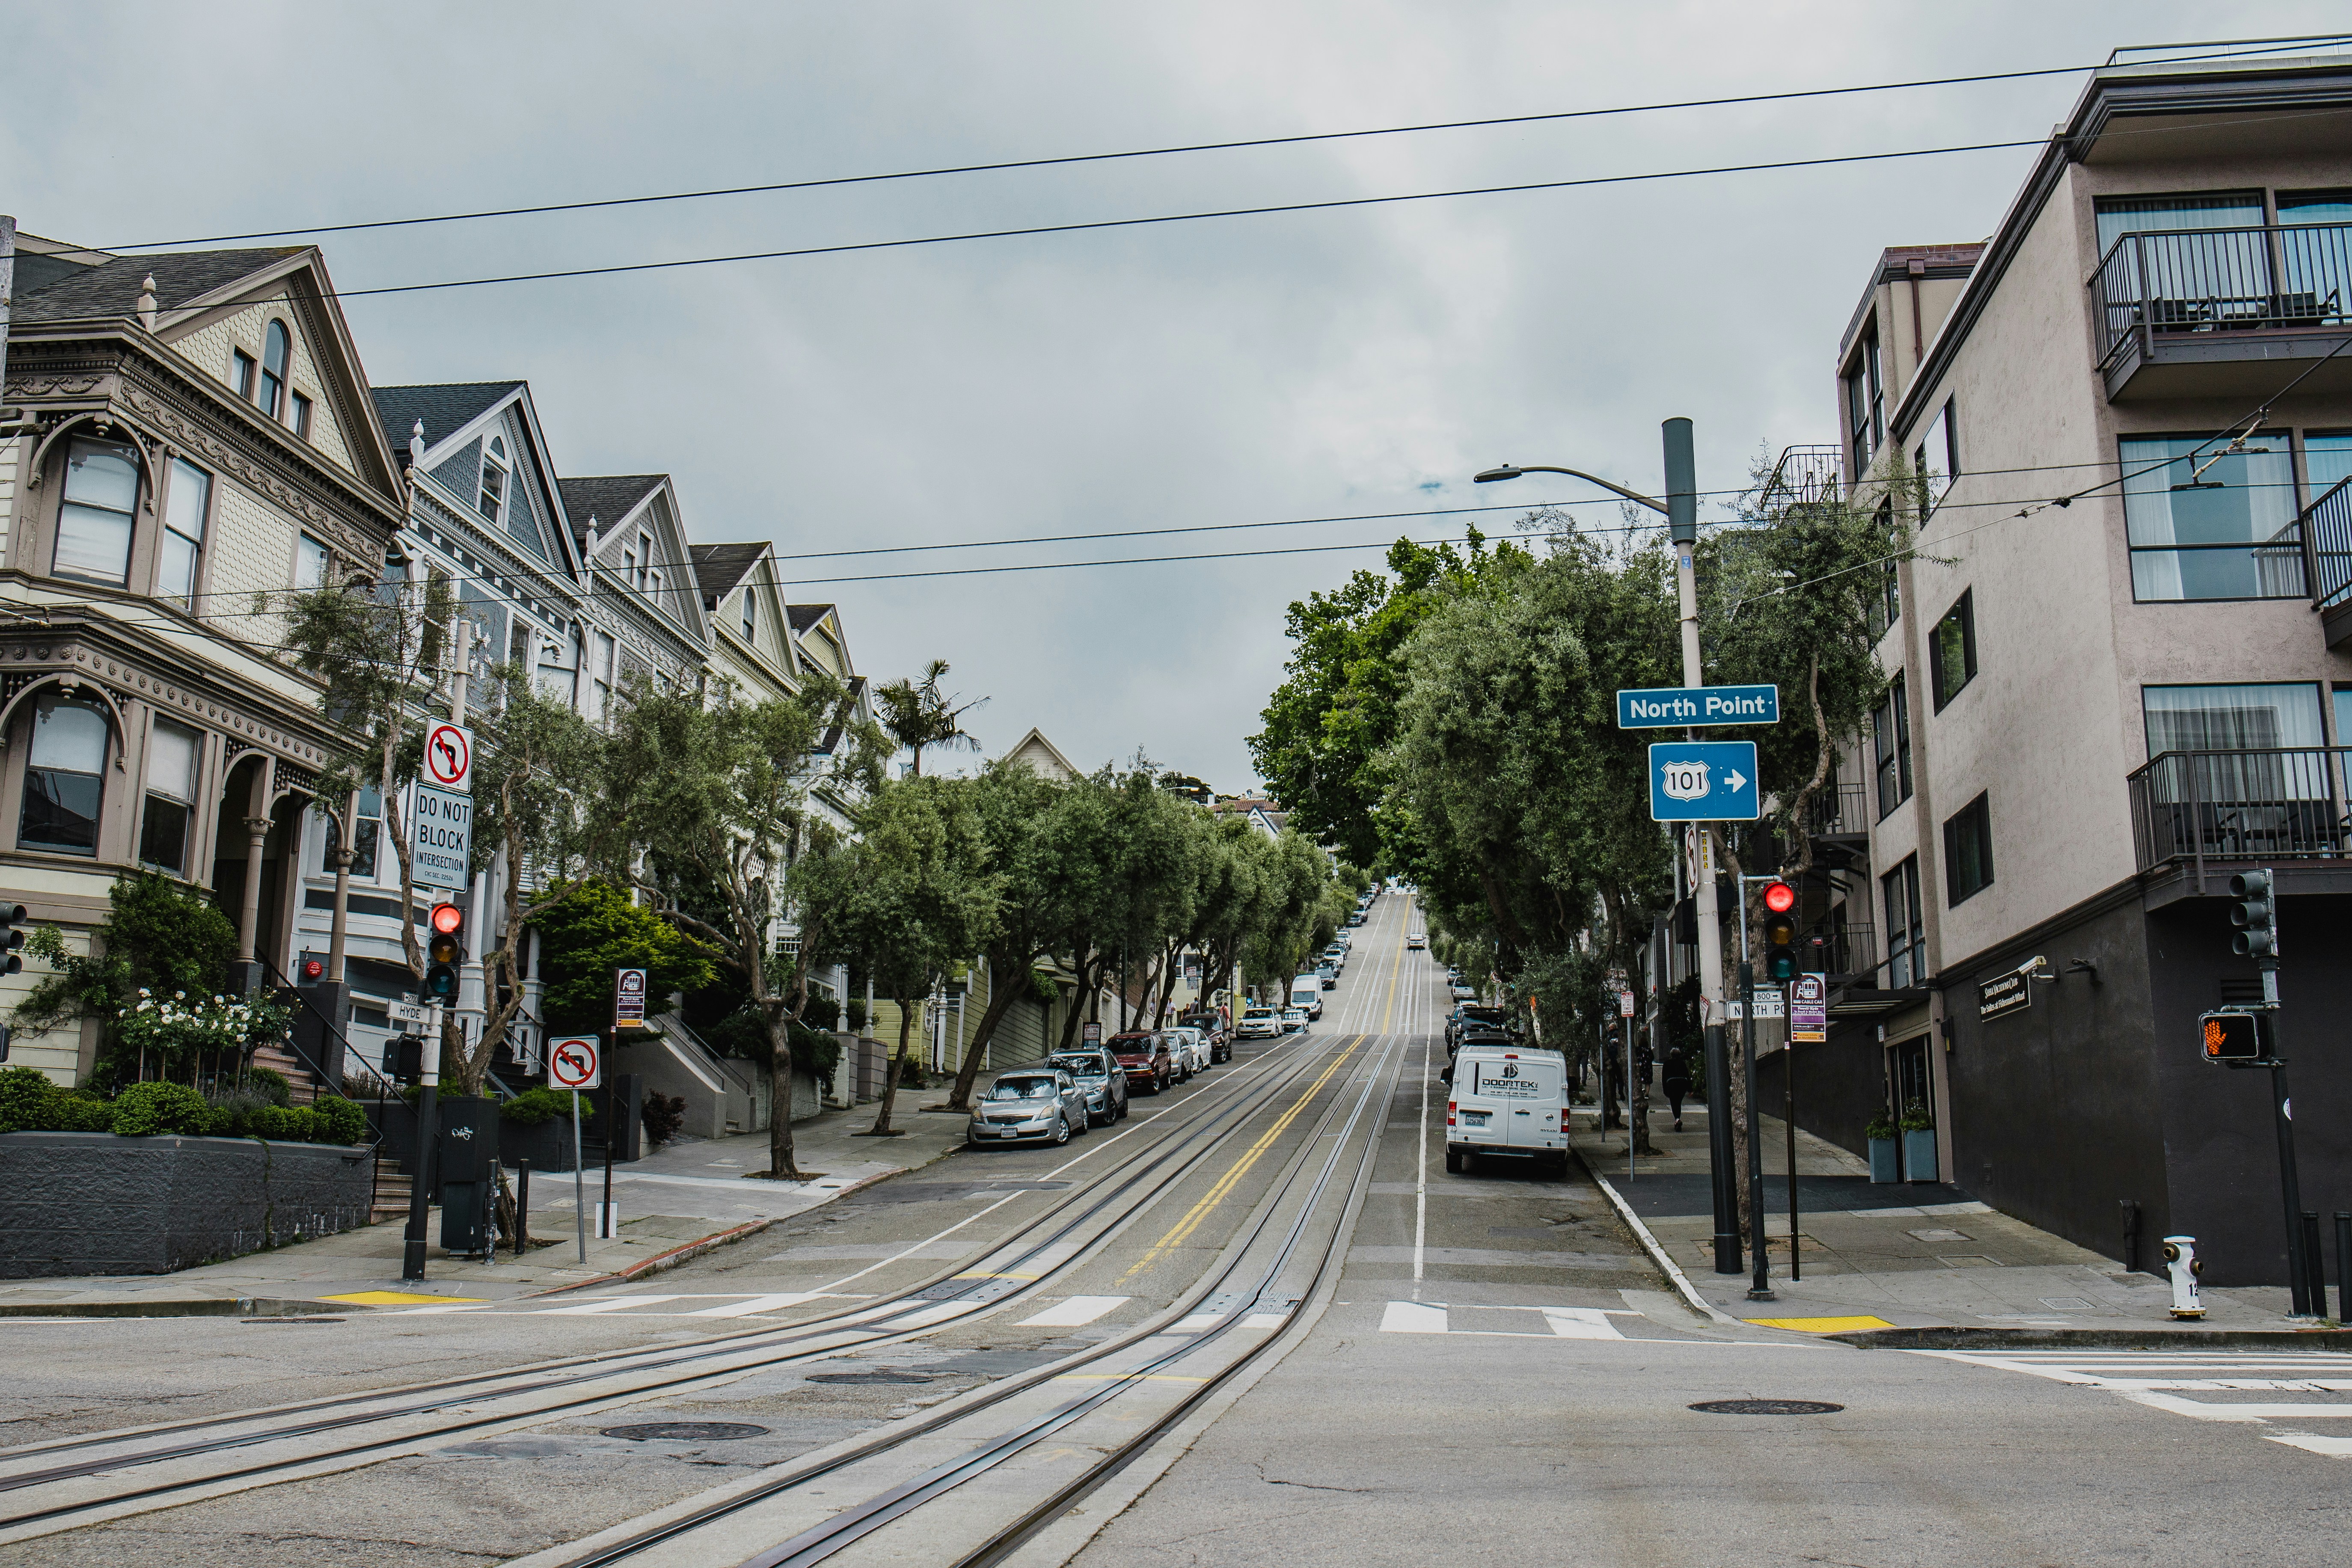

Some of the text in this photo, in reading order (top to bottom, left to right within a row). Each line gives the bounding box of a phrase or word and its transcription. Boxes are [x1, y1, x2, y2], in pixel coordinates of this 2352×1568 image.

[1630, 695, 1765, 718] North Point
[1671, 772, 1702, 790] 101
[419, 794, 469, 823] DO NOT
[420, 824, 464, 852] BLOCK
[416, 850, 464, 872] INTERSECTION
[400, 1005, 421, 1019] HYDE
[1986, 1003, 1995, 1012] Suites
[2015, 990, 2025, 1002] Wharf
[1482, 1078, 1535, 1087] DOORTEK
